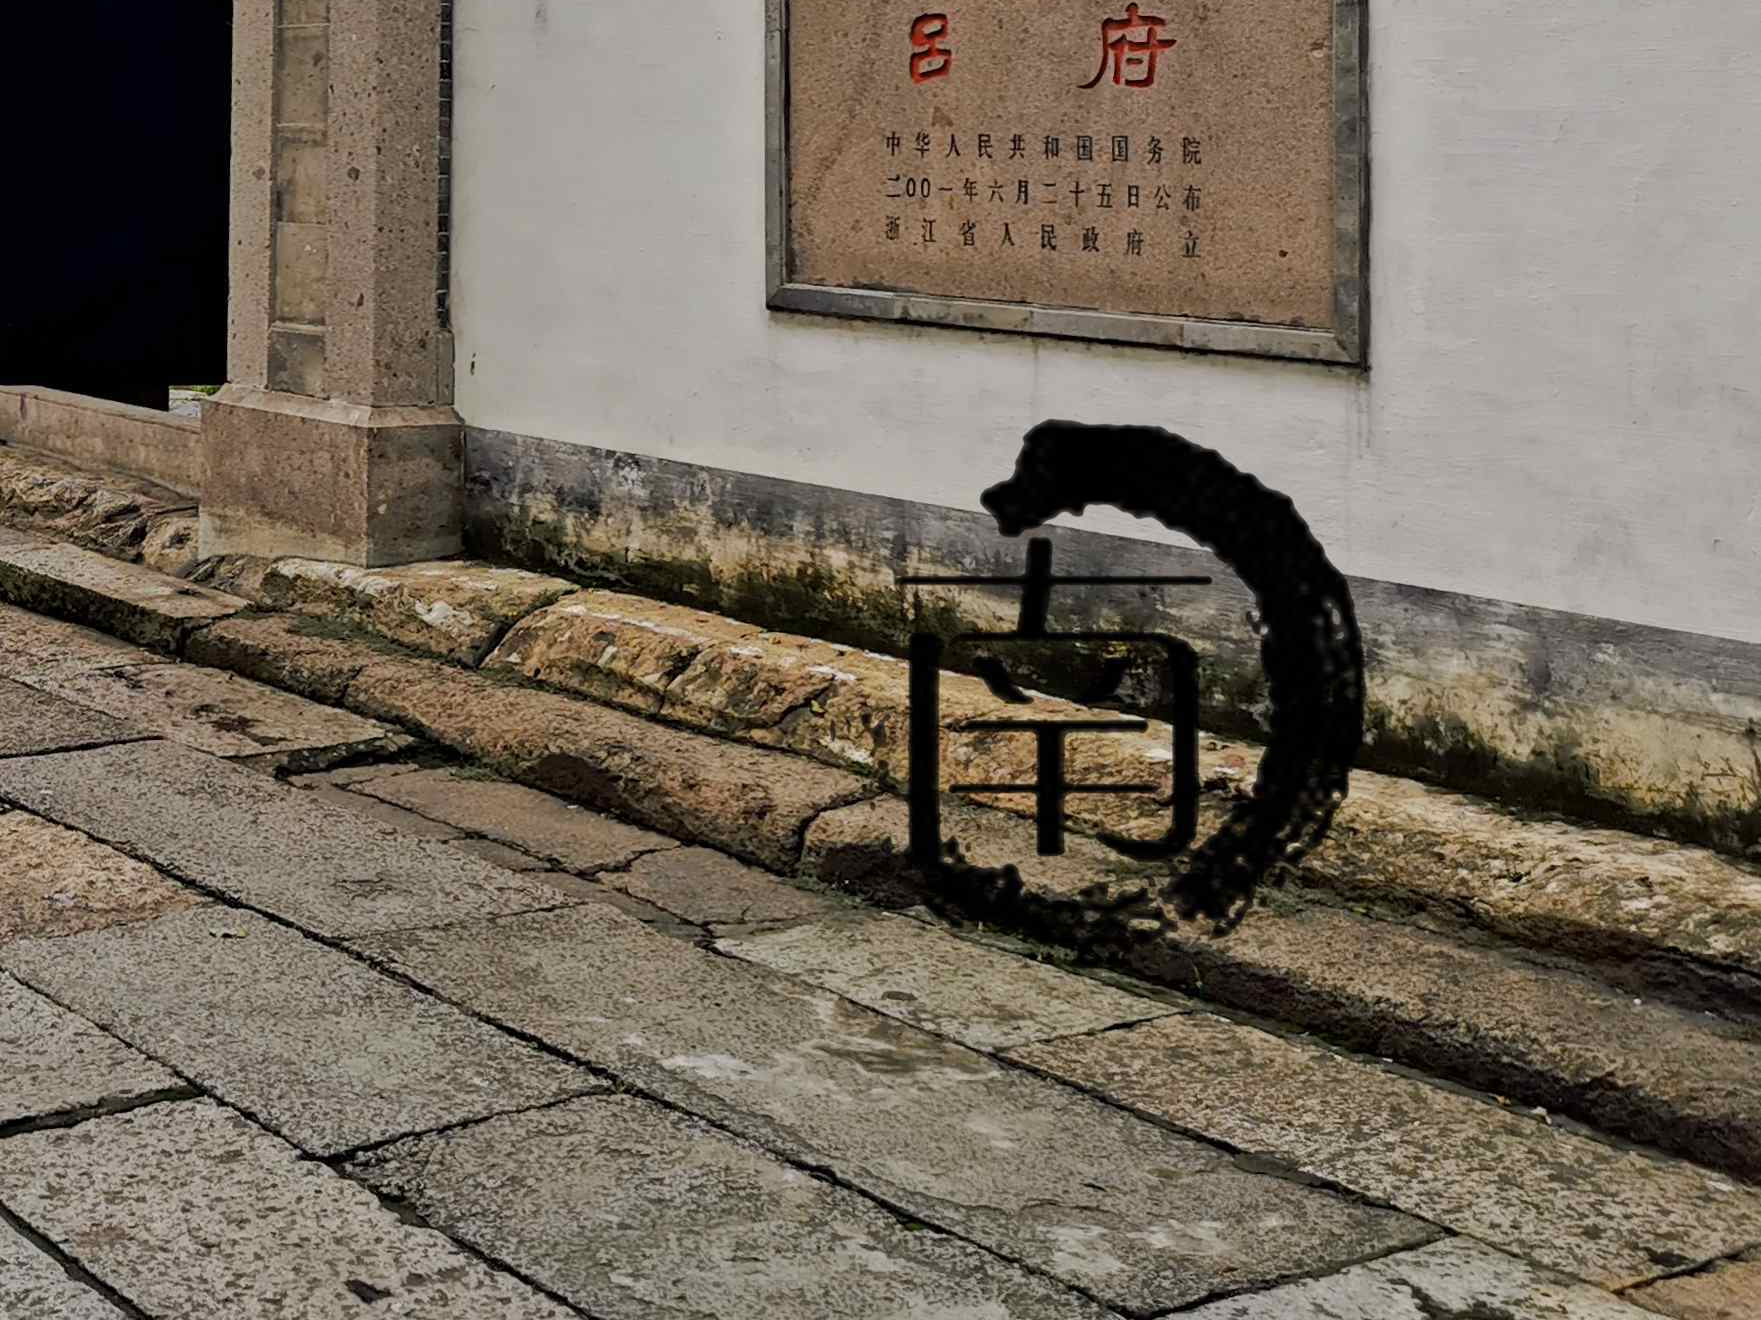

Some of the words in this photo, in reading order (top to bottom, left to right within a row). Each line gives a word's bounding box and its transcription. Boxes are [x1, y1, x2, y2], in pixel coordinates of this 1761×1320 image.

[885, 129, 1202, 165] 中华人民共和国国务院
